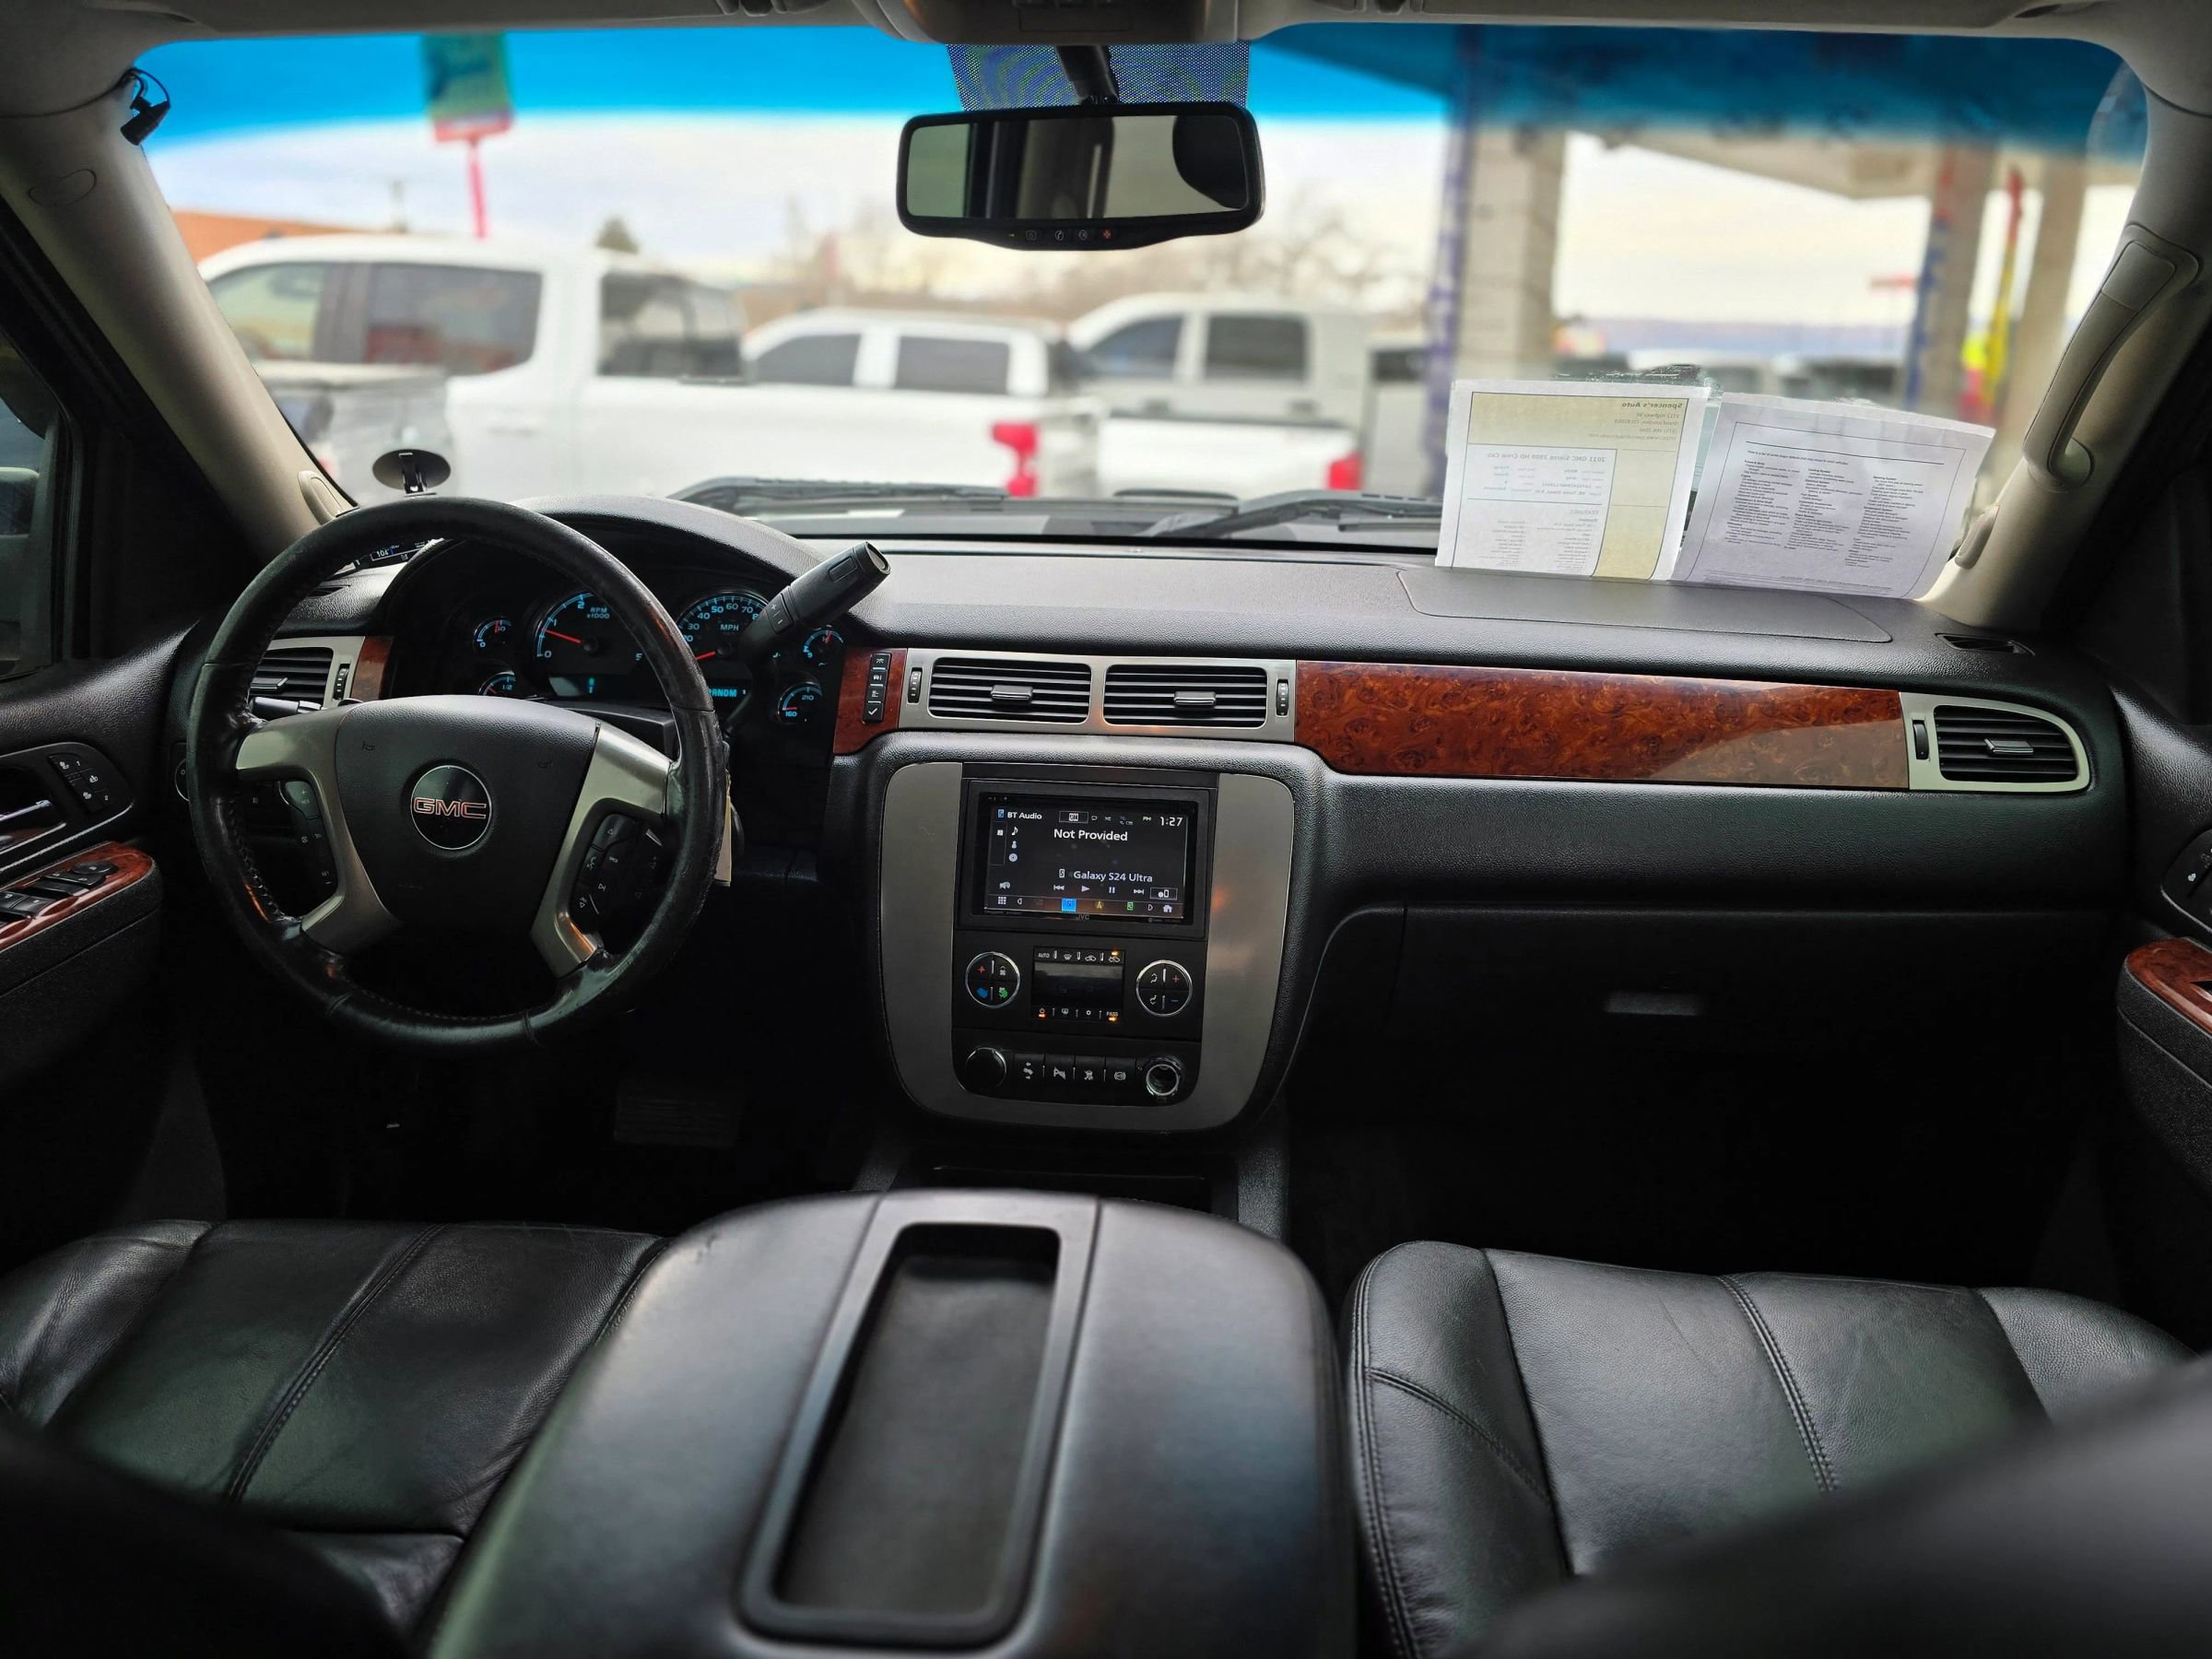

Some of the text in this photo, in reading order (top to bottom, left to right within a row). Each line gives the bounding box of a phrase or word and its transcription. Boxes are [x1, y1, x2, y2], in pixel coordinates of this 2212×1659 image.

[711, 605, 725, 614] 50
[741, 606, 754, 614] 70
[697, 610, 711, 619] 40
[688, 622, 701, 630] 30
[720, 623, 740, 631] MPH
[413, 796, 488, 820] GMC
[1006, 811, 1043, 820] BT Audio
[1159, 816, 1183, 828] 1:27
[1053, 828, 1129, 842] Not Provided
[1073, 870, 1154, 883] Galaxy S24 Ultra
[1037, 951, 1051, 959] AUTO
